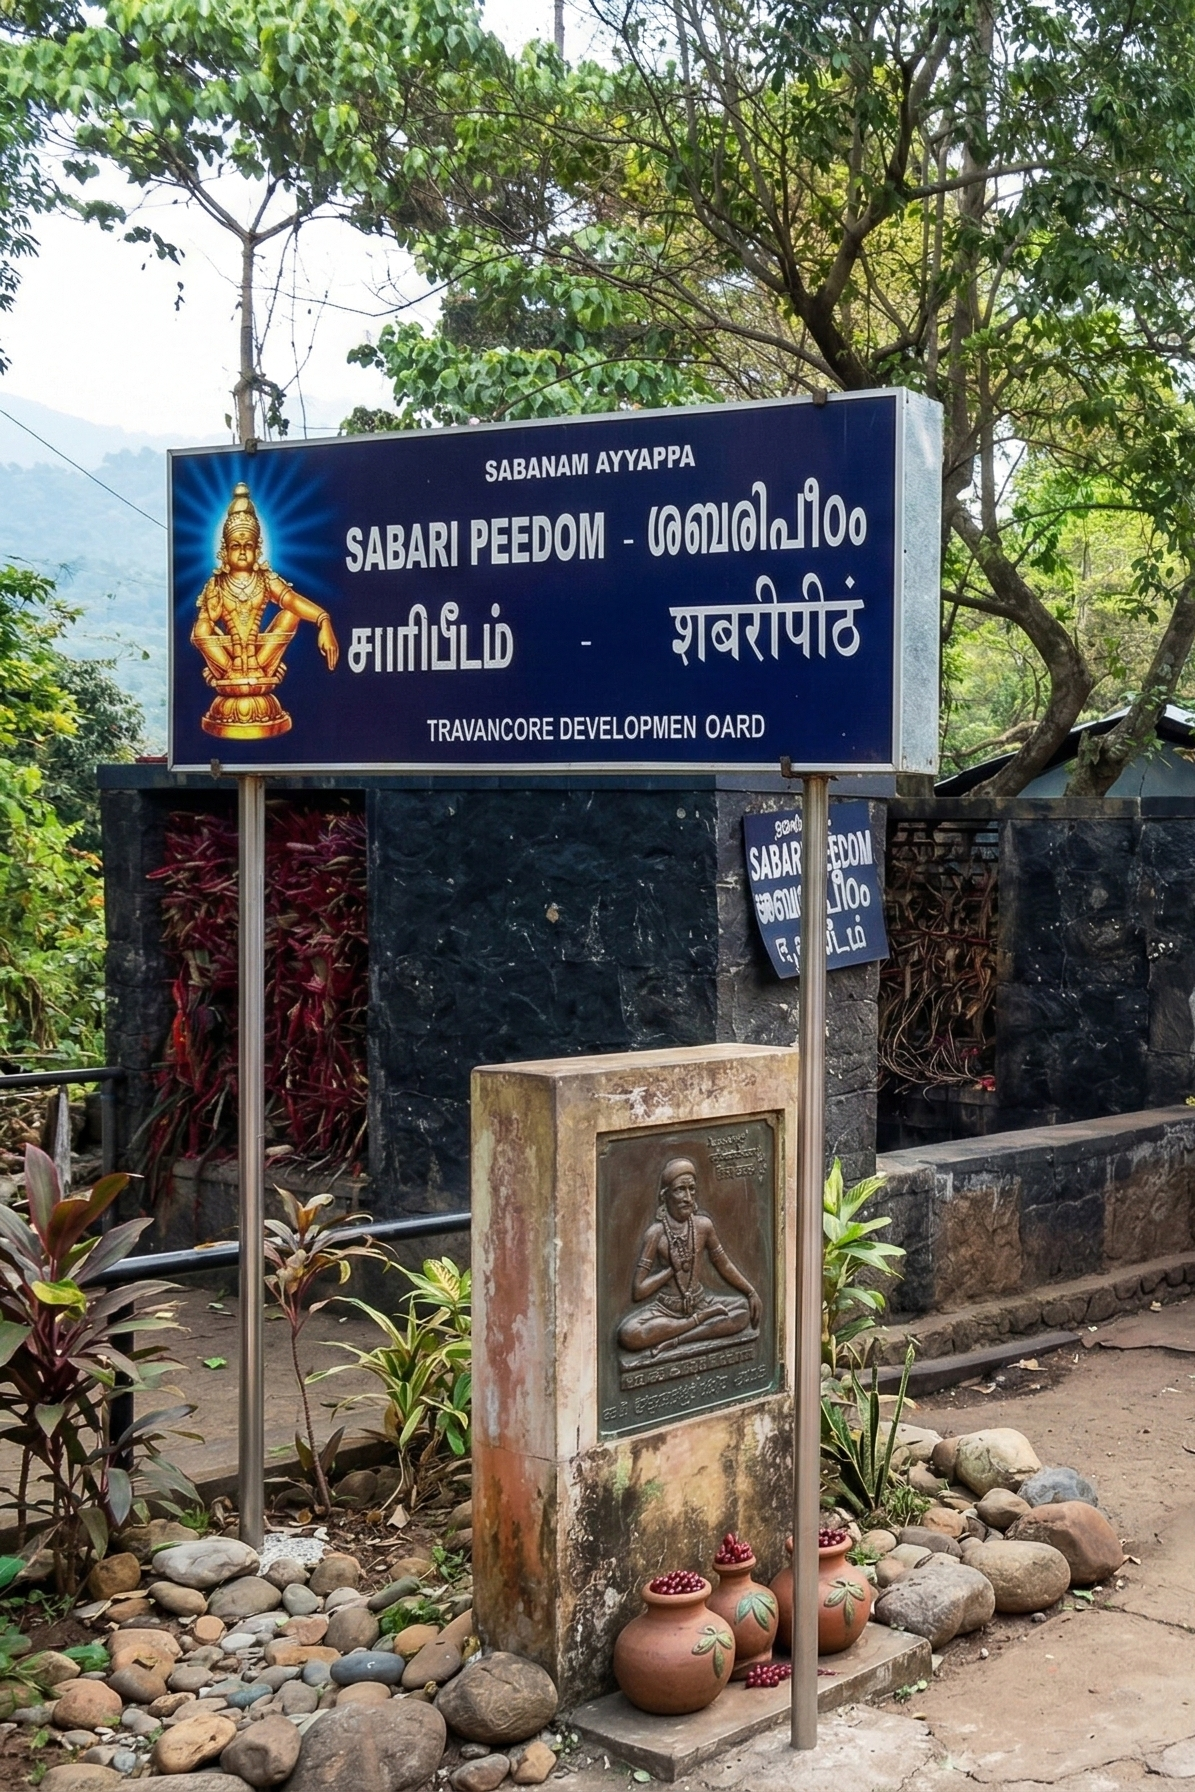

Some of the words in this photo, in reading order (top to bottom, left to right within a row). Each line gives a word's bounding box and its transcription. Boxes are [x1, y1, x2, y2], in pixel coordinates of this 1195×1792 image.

[484, 452, 589, 483] SABANAM
[595, 444, 696, 474] AYYAPPA
[345, 520, 459, 573] SABARI
[470, 511, 605, 566] PEEDOM
[668, 572, 865, 667] शबरीपीठं
[427, 717, 554, 743] TRAVANCORE
[559, 715, 697, 740] DEVELOPMEN
[705, 714, 766, 739] OARD
[749, 840, 803, 882] SABAR
